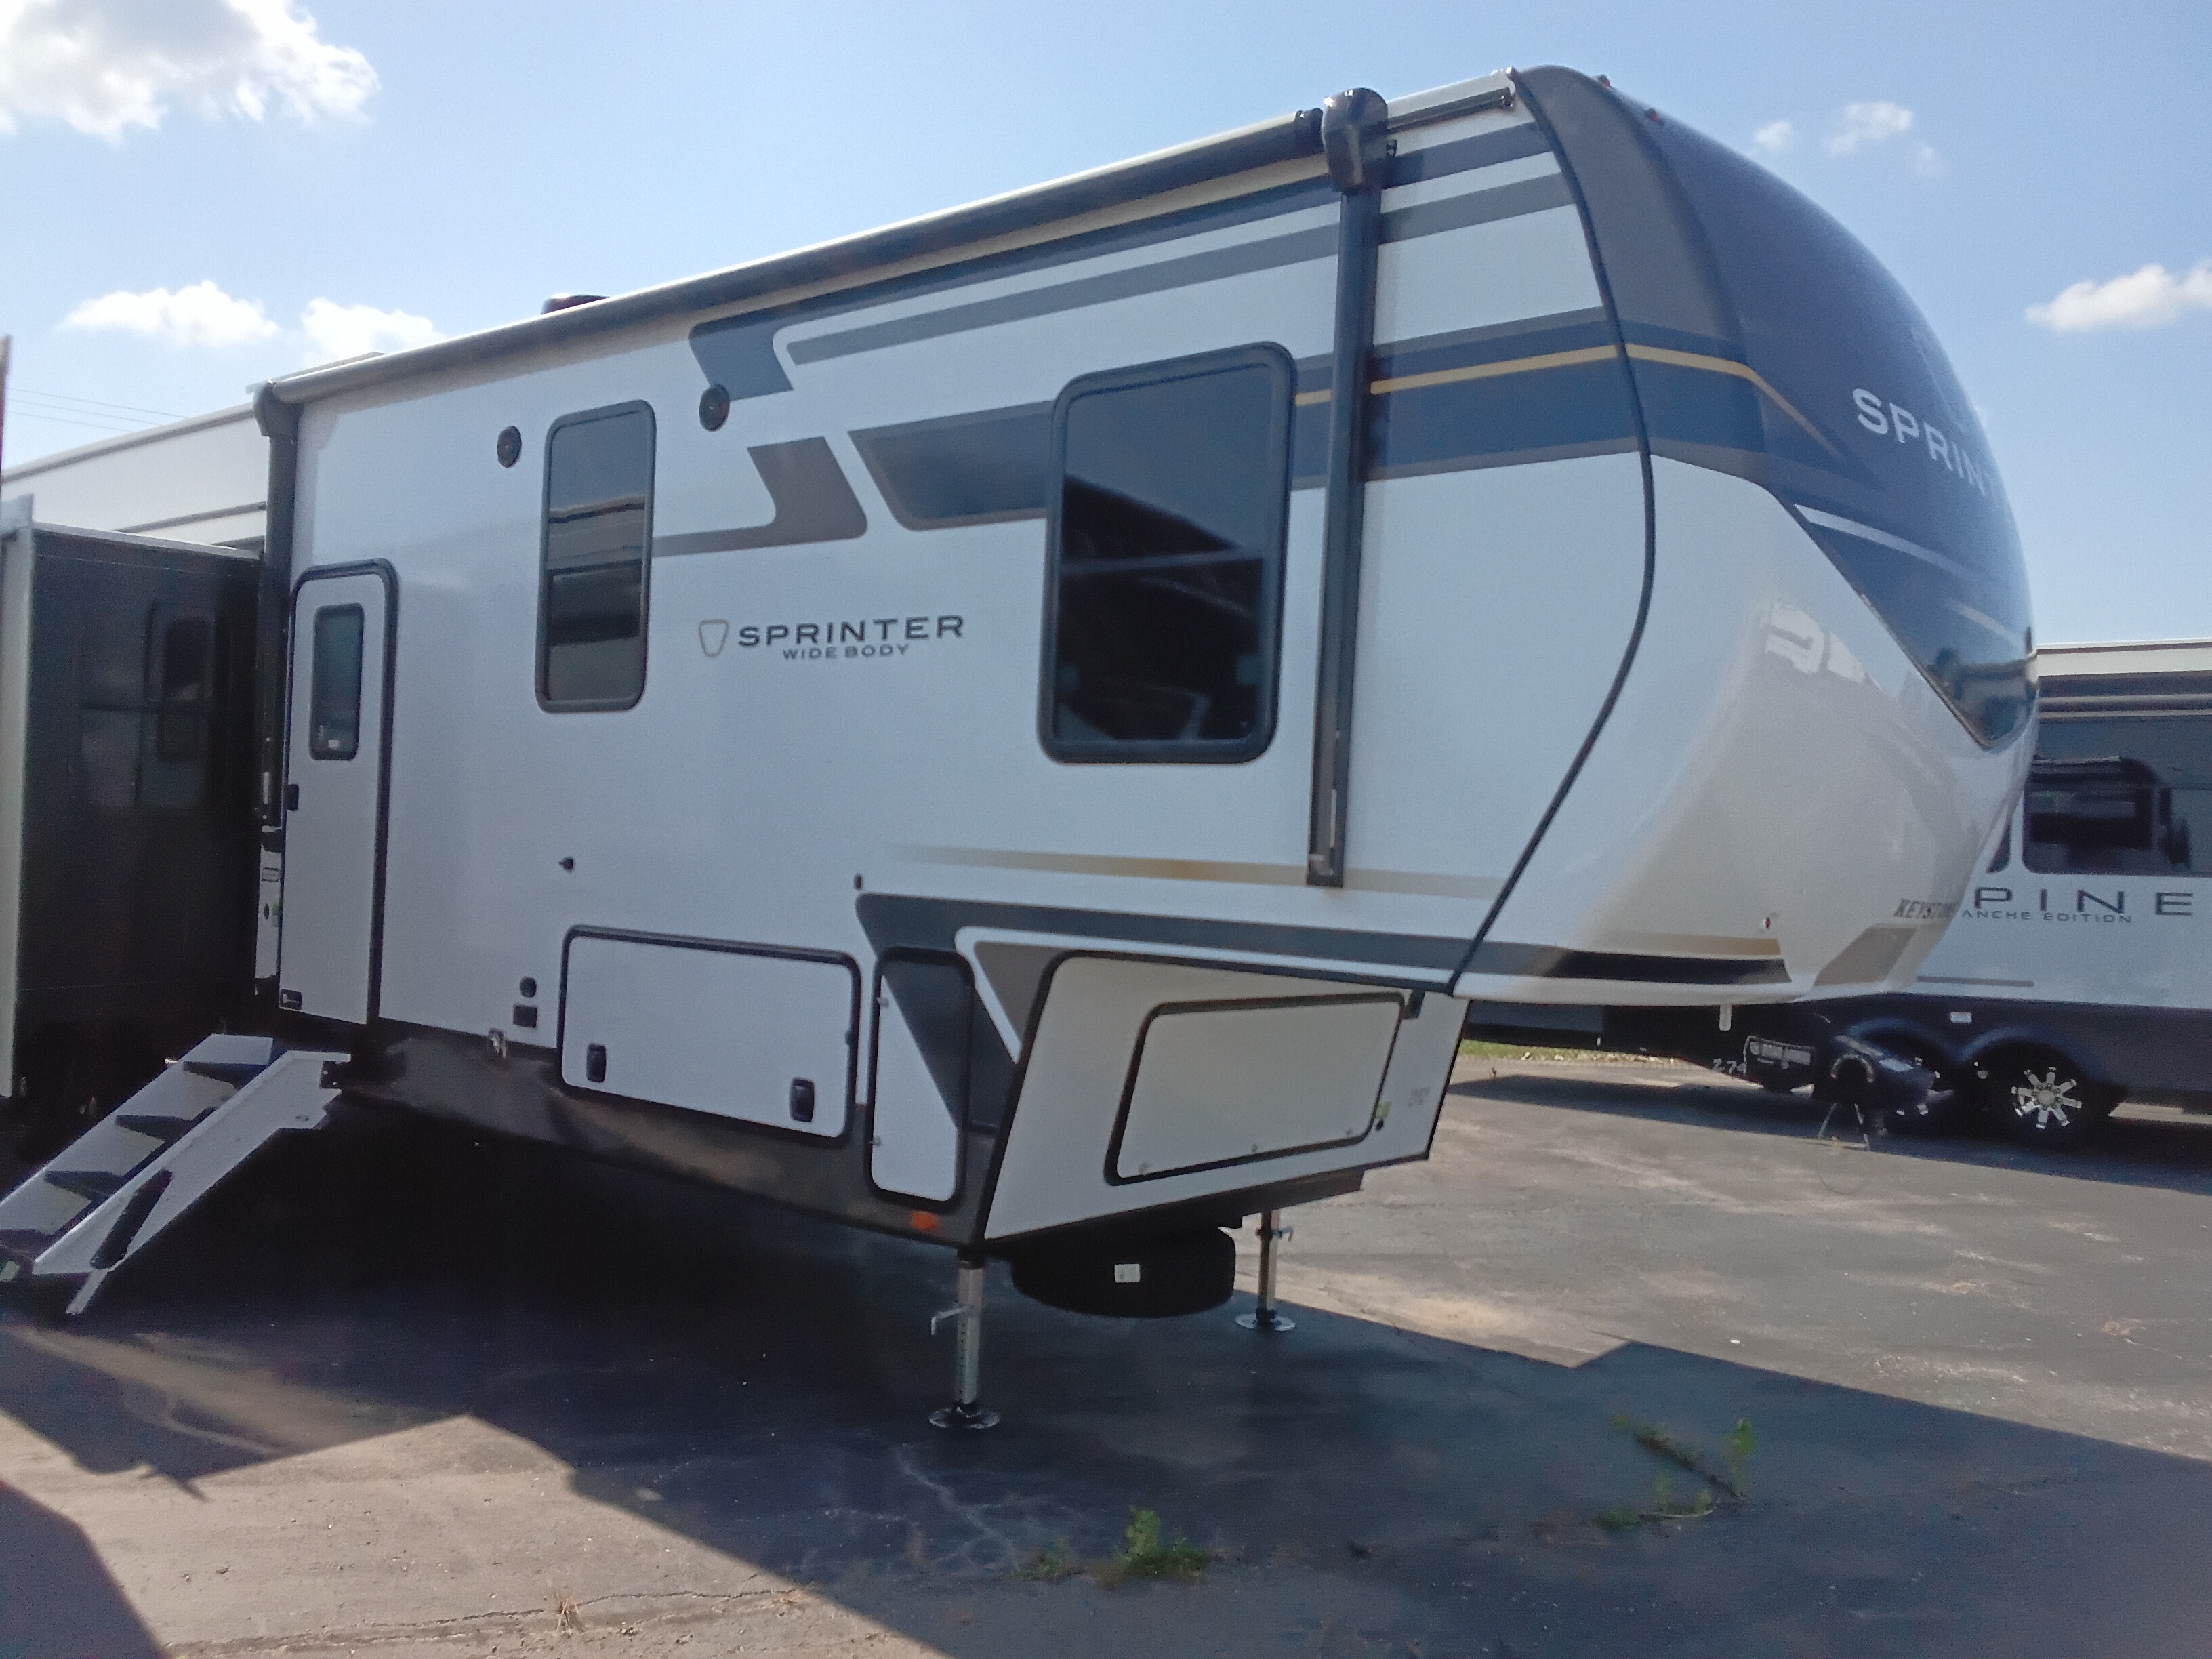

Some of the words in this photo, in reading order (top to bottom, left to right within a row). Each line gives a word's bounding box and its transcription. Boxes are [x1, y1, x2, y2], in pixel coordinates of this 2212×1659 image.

[738, 615, 964, 647] SPRINTER
[782, 645, 838, 660] WIDE
[845, 643, 909, 659] BODY
[1974, 886, 2194, 916] PINE
[1961, 909, 2030, 920] ANCHE
[2043, 911, 2133, 924] EDITION
